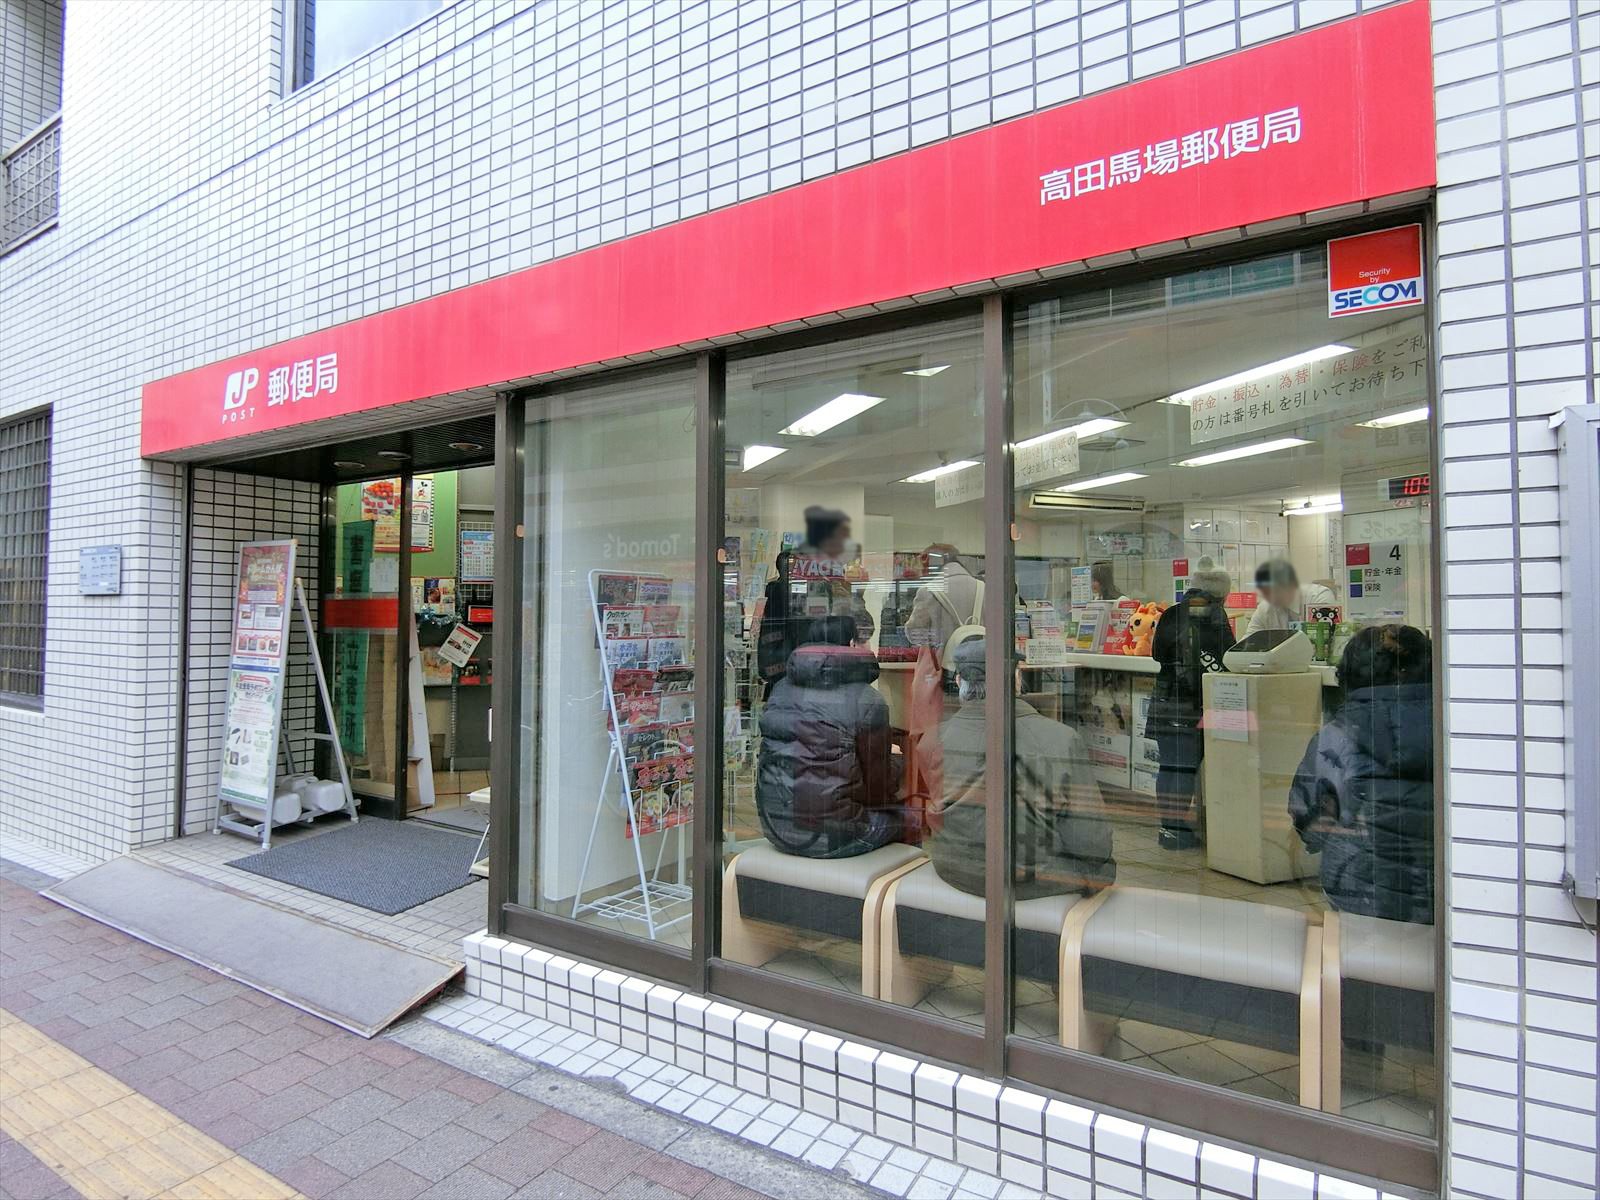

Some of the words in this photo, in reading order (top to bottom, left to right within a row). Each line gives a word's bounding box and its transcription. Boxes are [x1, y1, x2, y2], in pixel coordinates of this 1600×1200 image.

[1039, 106, 1301, 206] 高田馬場郵便局
[1358, 267, 1391, 279] Security
[1369, 276, 1380, 284] by
[1334, 281, 1417, 310] SECOM
[267, 352, 338, 407] 郵便局
[221, 407, 256, 424] POST
[1389, 544, 1402, 561] 4
[1364, 566, 1402, 578] 貯金・年金
[1364, 583, 1381, 592] 保険
